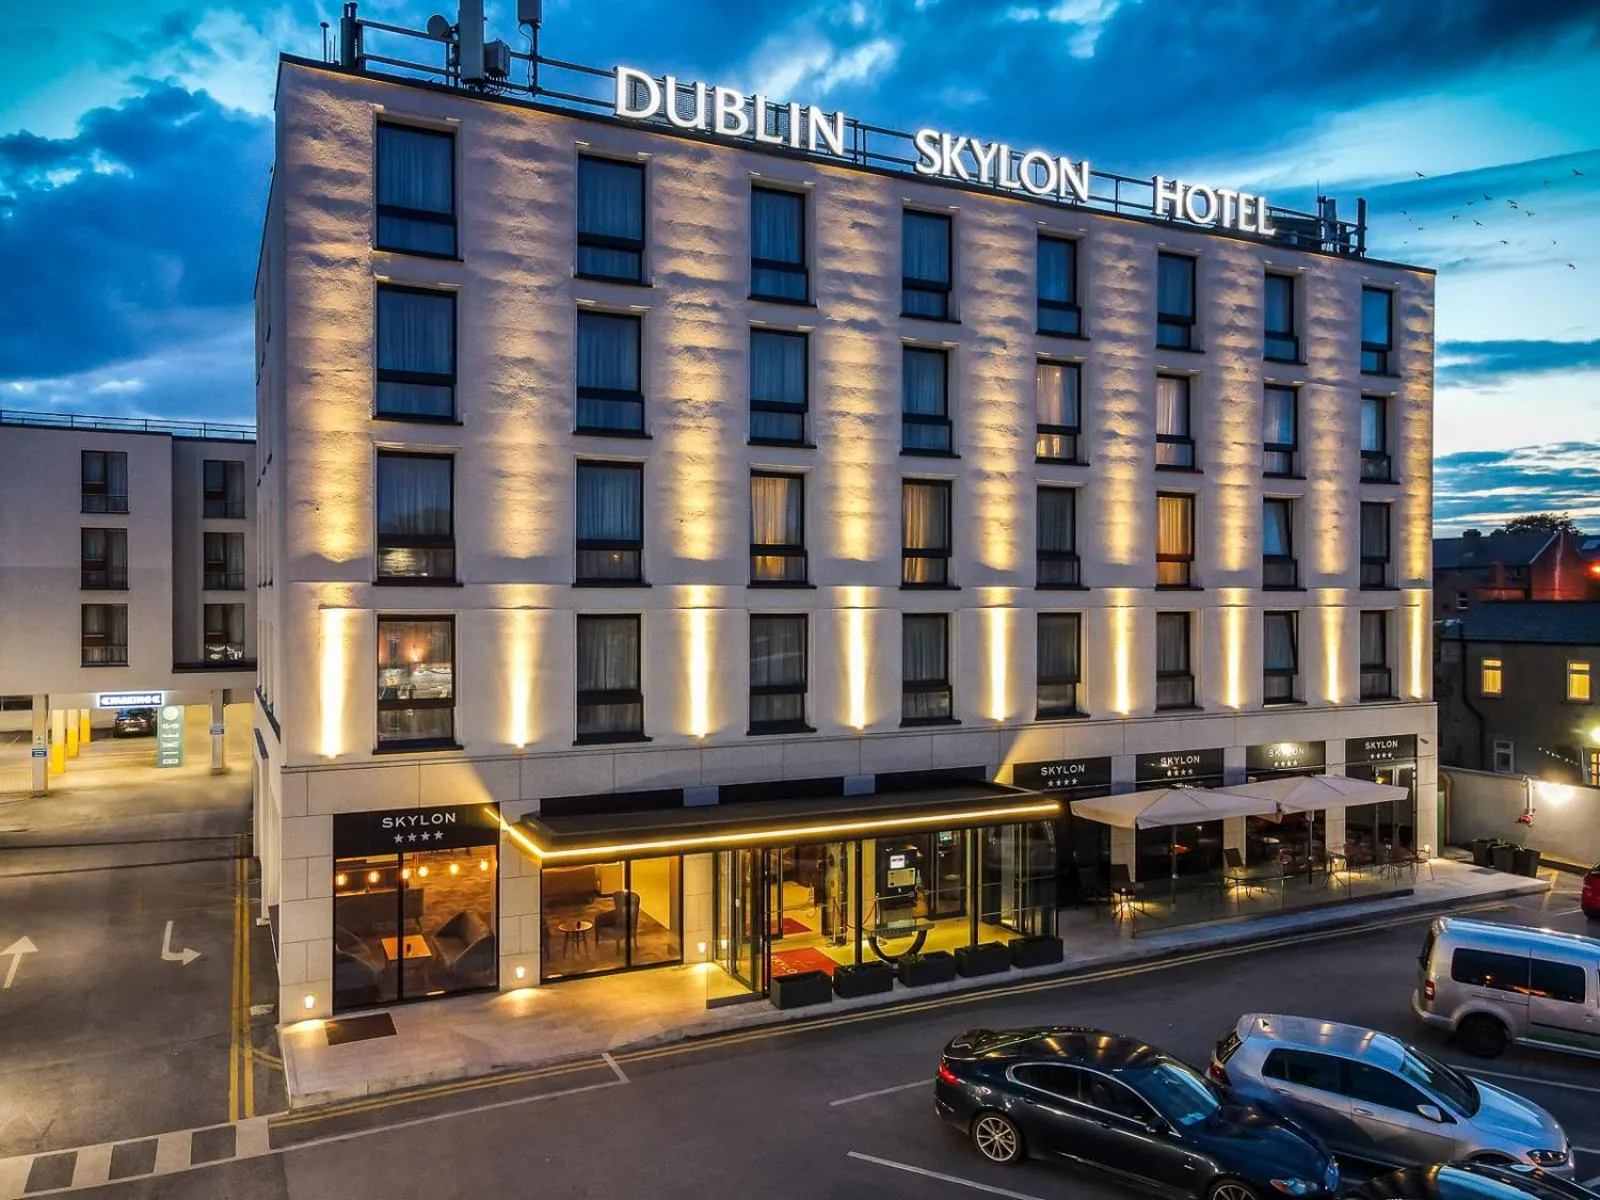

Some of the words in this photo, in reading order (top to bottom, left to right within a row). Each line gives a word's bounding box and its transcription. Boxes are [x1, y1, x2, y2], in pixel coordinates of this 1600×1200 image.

[615, 66, 844, 156] DUBLIN
[914, 128, 1090, 203] SKYLON
[1154, 175, 1276, 236] HOTEL
[1364, 739, 1398, 750] SKYLON
[1267, 746, 1305, 758] SKON
[1160, 755, 1201, 767] SKYLON
[1040, 764, 1085, 776] SKYLON
[381, 812, 456, 829] SKYLON
